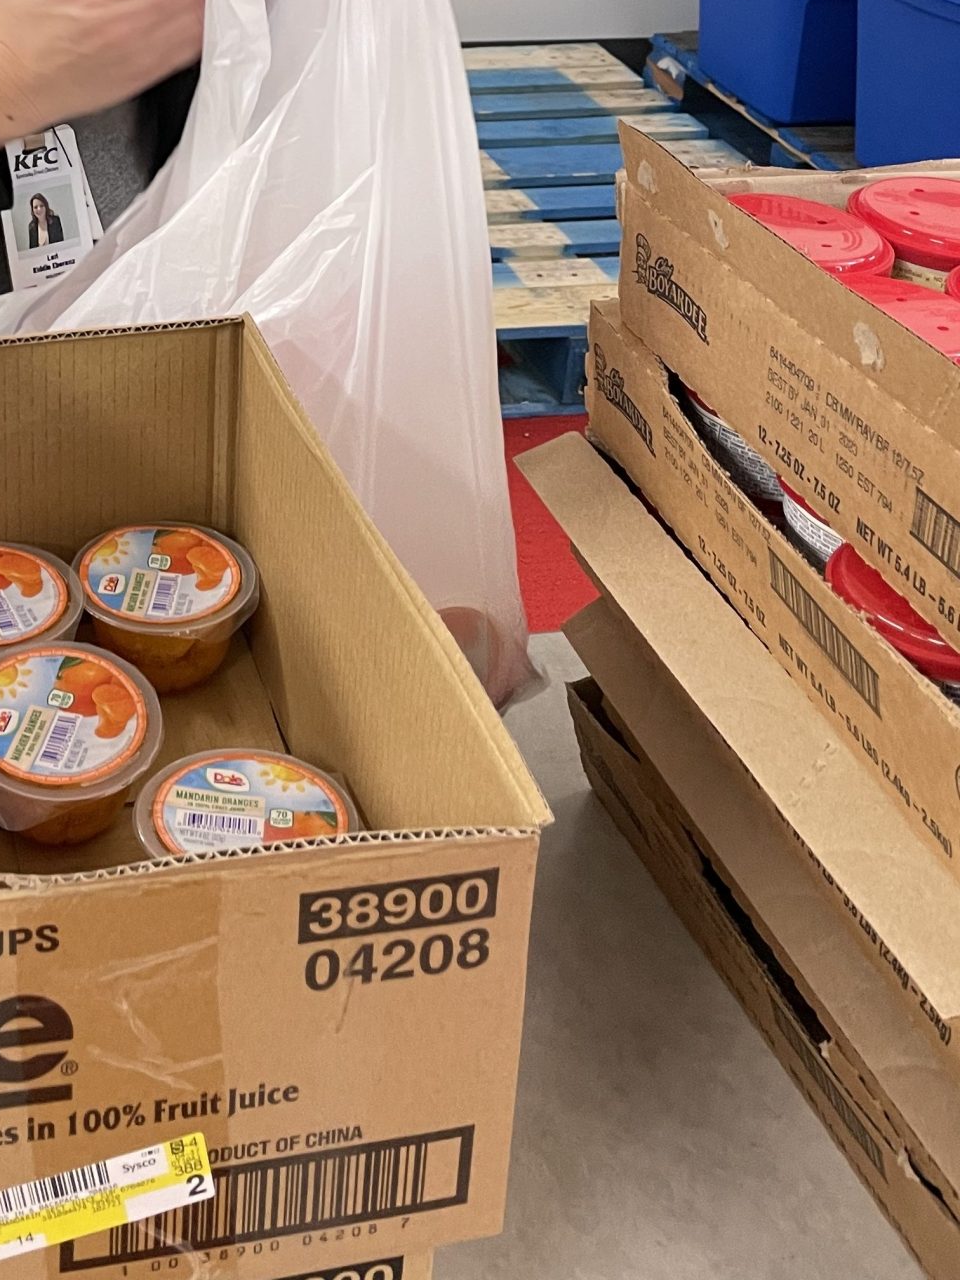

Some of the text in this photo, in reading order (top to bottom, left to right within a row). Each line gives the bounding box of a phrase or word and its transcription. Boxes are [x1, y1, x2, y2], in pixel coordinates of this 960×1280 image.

[14, 147, 58, 172] KFC
[655, 256, 674, 280] Chef
[647, 265, 708, 345] BOYARDEE
[604, 376, 656, 457] BOYARDEE
[767, 367, 787, 394] BEST
[790, 385, 800, 402] BY
[801, 399, 817, 421] JAN
[758, 424, 767, 446] 12
[775, 440, 792, 468] 7.25
[793, 457, 805, 481] OZ
[814, 476, 826, 501] 7.5
[828, 492, 841, 514] OZ
[857, 471, 876, 497] EST
[857, 516, 955, 624] NET WT 5.4 LB 5.6
[778, 632, 793, 661] NET
[796, 655, 808, 679] WT
[825, 689, 836, 713] LB
[176, 790, 259, 809] MANDARIN ORANGES
[213, 772, 246, 787] Dole
[275, 810, 288, 818] 70
[308, 878, 490, 935] 38900
[304, 927, 491, 992] 04208
[27, 1116, 56, 1142] in
[68, 1101, 146, 1137] 100%
[154, 1089, 223, 1123] Fruit
[228, 1083, 300, 1118] Juice
[122, 1157, 157, 1174] Sysco
[209, 1125, 363, 1165] ODUCT OF CHINA
[186, 1174, 207, 1197] 2
[16, 1232, 34, 1247] 14
[151, 1257, 180, 1272] 00
[201, 1240, 281, 1264] 38900
[303, 1222, 378, 1247] 04208
[400, 1216, 411, 1229] 7
